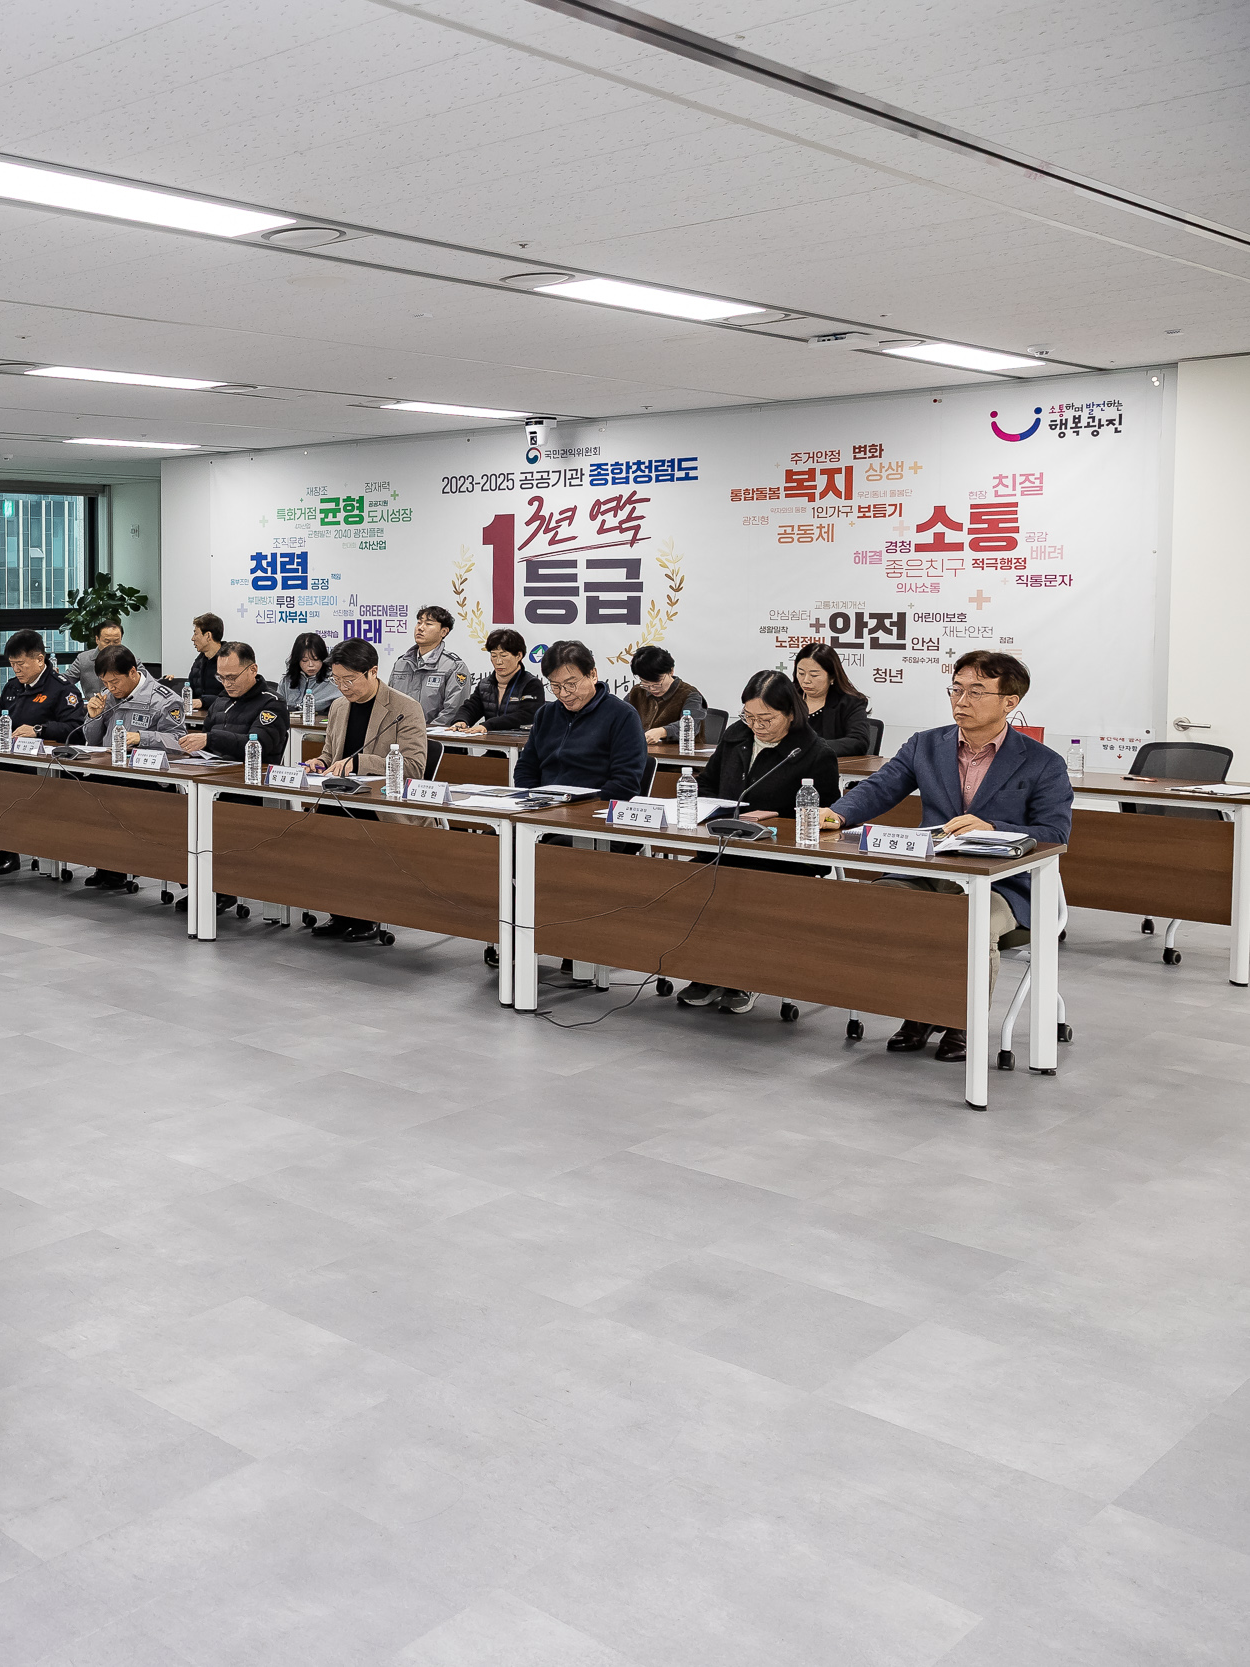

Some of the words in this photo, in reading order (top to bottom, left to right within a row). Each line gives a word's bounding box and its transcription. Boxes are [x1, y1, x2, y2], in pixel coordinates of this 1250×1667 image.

[1049, 403, 1084, 417] 소통하며
[1048, 413, 1123, 439] 행복광진
[544, 446, 601, 460] 국민권익위원회
[790, 449, 841, 466] 주거안정
[852, 443, 885, 461] 변화
[441, 472, 515, 495] 2023-2025
[519, 467, 585, 490] 공공기관
[589, 456, 699, 487] 종합청렴도
[864, 460, 905, 482] 상생
[364, 481, 391, 493] 잠재력
[784, 465, 854, 503] 복지
[992, 472, 1045, 498] 친절
[730, 486, 781, 502] 통합돌봄
[276, 506, 317, 521] 특화거점
[319, 495, 365, 526] 균형
[367, 508, 413, 524] 도시성장
[811, 505, 853, 519] 1인가구
[857, 503, 903, 519] 보듬기
[518, 495, 579, 551] 3년
[589, 490, 651, 548] 연속
[914, 501, 1020, 553] 소통
[334, 528, 352, 539] 2040
[353, 527, 384, 539] 광진플랜
[777, 523, 835, 545] 공동체
[1025, 531, 1048, 543] 공감
[273, 536, 306, 549] 조직문화
[358, 540, 387, 550] 4차산업
[885, 540, 912, 554] 경청
[853, 550, 883, 565] 해결
[1030, 544, 1064, 561] 배려
[250, 551, 308, 591] 청렴
[885, 558, 965, 579] 좋은친구
[971, 557, 1027, 571] 적극행정
[311, 578, 329, 590] 공정
[896, 582, 941, 594] 의사소통
[1015, 574, 1073, 588] 직통문자
[276, 595, 295, 609] 투명
[297, 595, 338, 606] 청렴지킴이
[349, 594, 358, 607] AI
[814, 600, 866, 610] 교통체계개선
[255, 609, 277, 624] 신뢰
[278, 610, 308, 624] 자부심
[359, 604, 408, 618] GREEN힐링
[913, 612, 967, 623] 어린이보호
[343, 618, 382, 644] 미래
[385, 619, 408, 634] 도전
[828, 611, 907, 650] 안전
[942, 625, 994, 639] 재난안전
[911, 637, 940, 651] 안심
[872, 667, 904, 684] 청년
